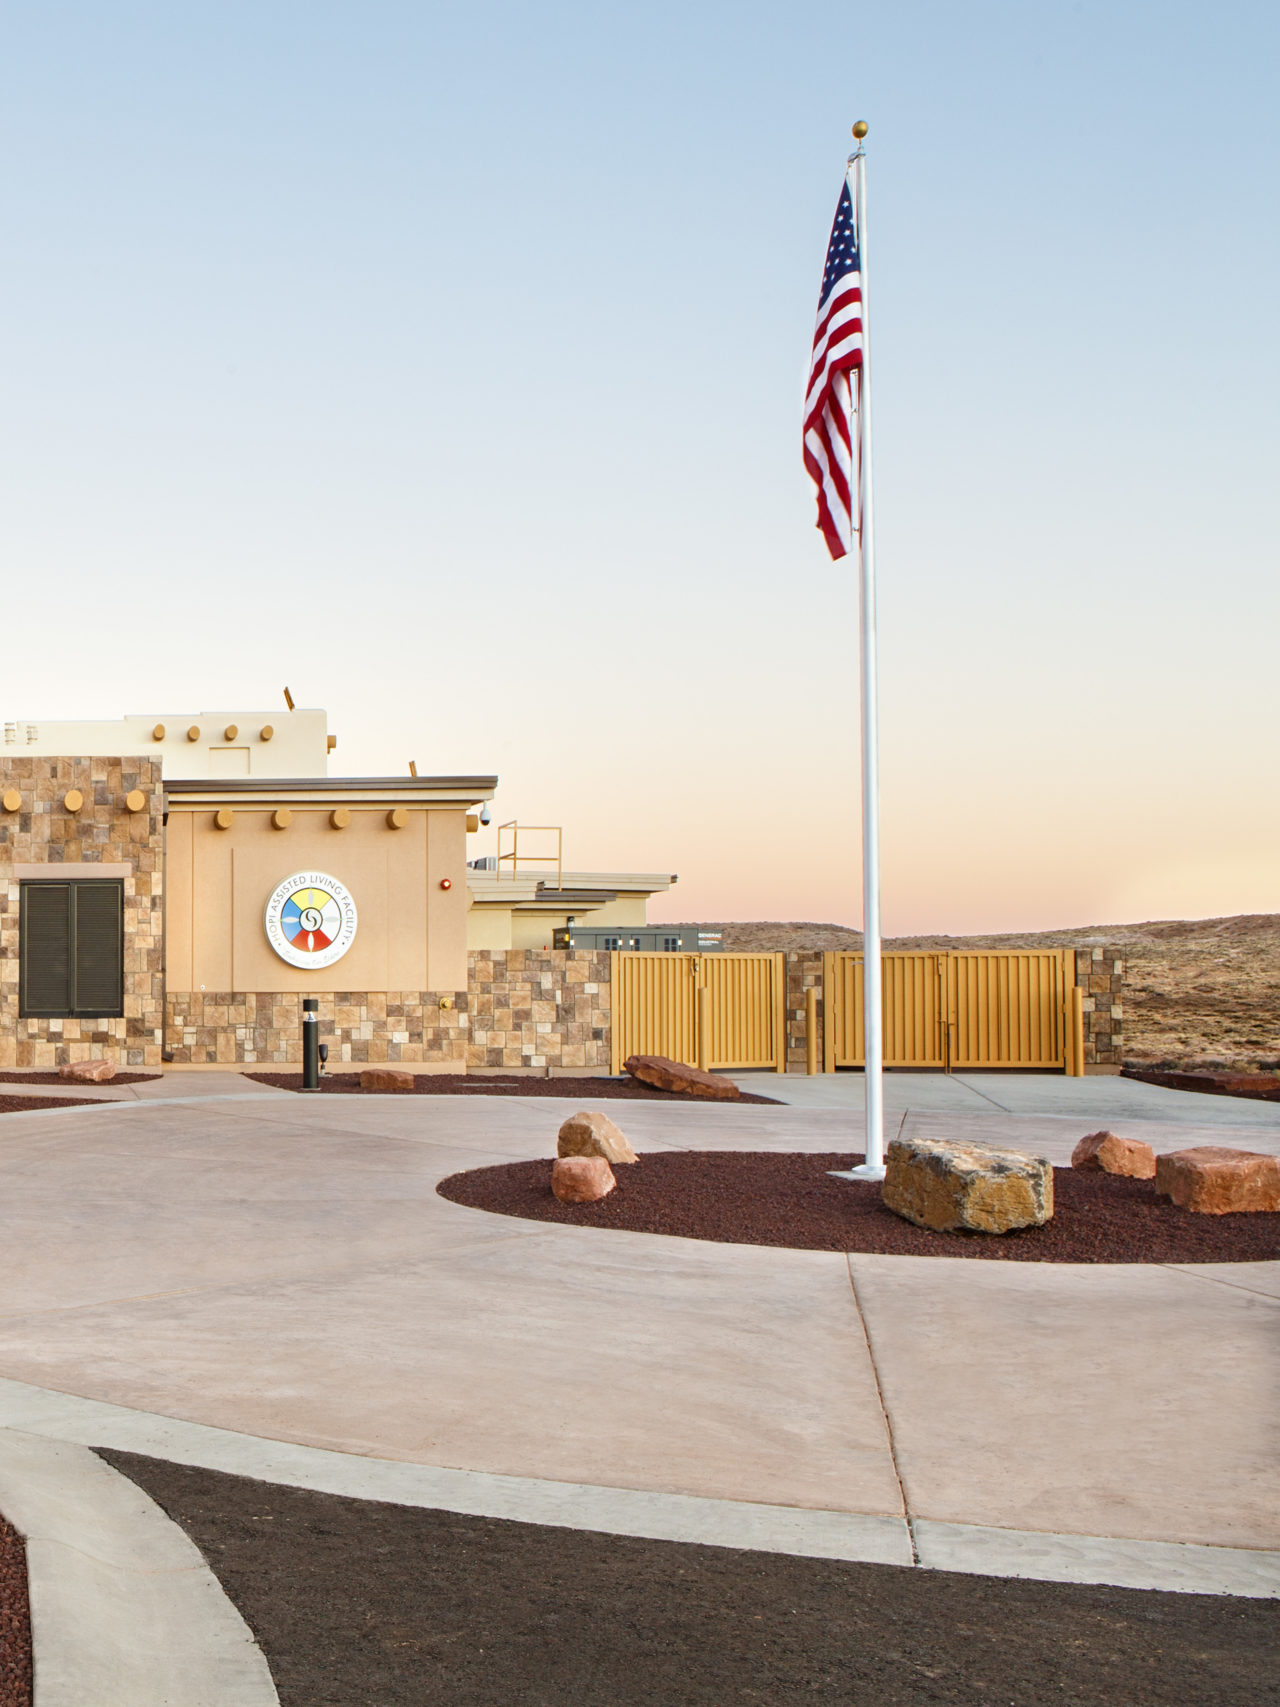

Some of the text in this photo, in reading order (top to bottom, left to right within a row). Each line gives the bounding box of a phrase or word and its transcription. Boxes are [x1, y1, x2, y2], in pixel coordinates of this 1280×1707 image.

[268, 875, 354, 942] HOPI ASSISTED LIVING FACILITY
